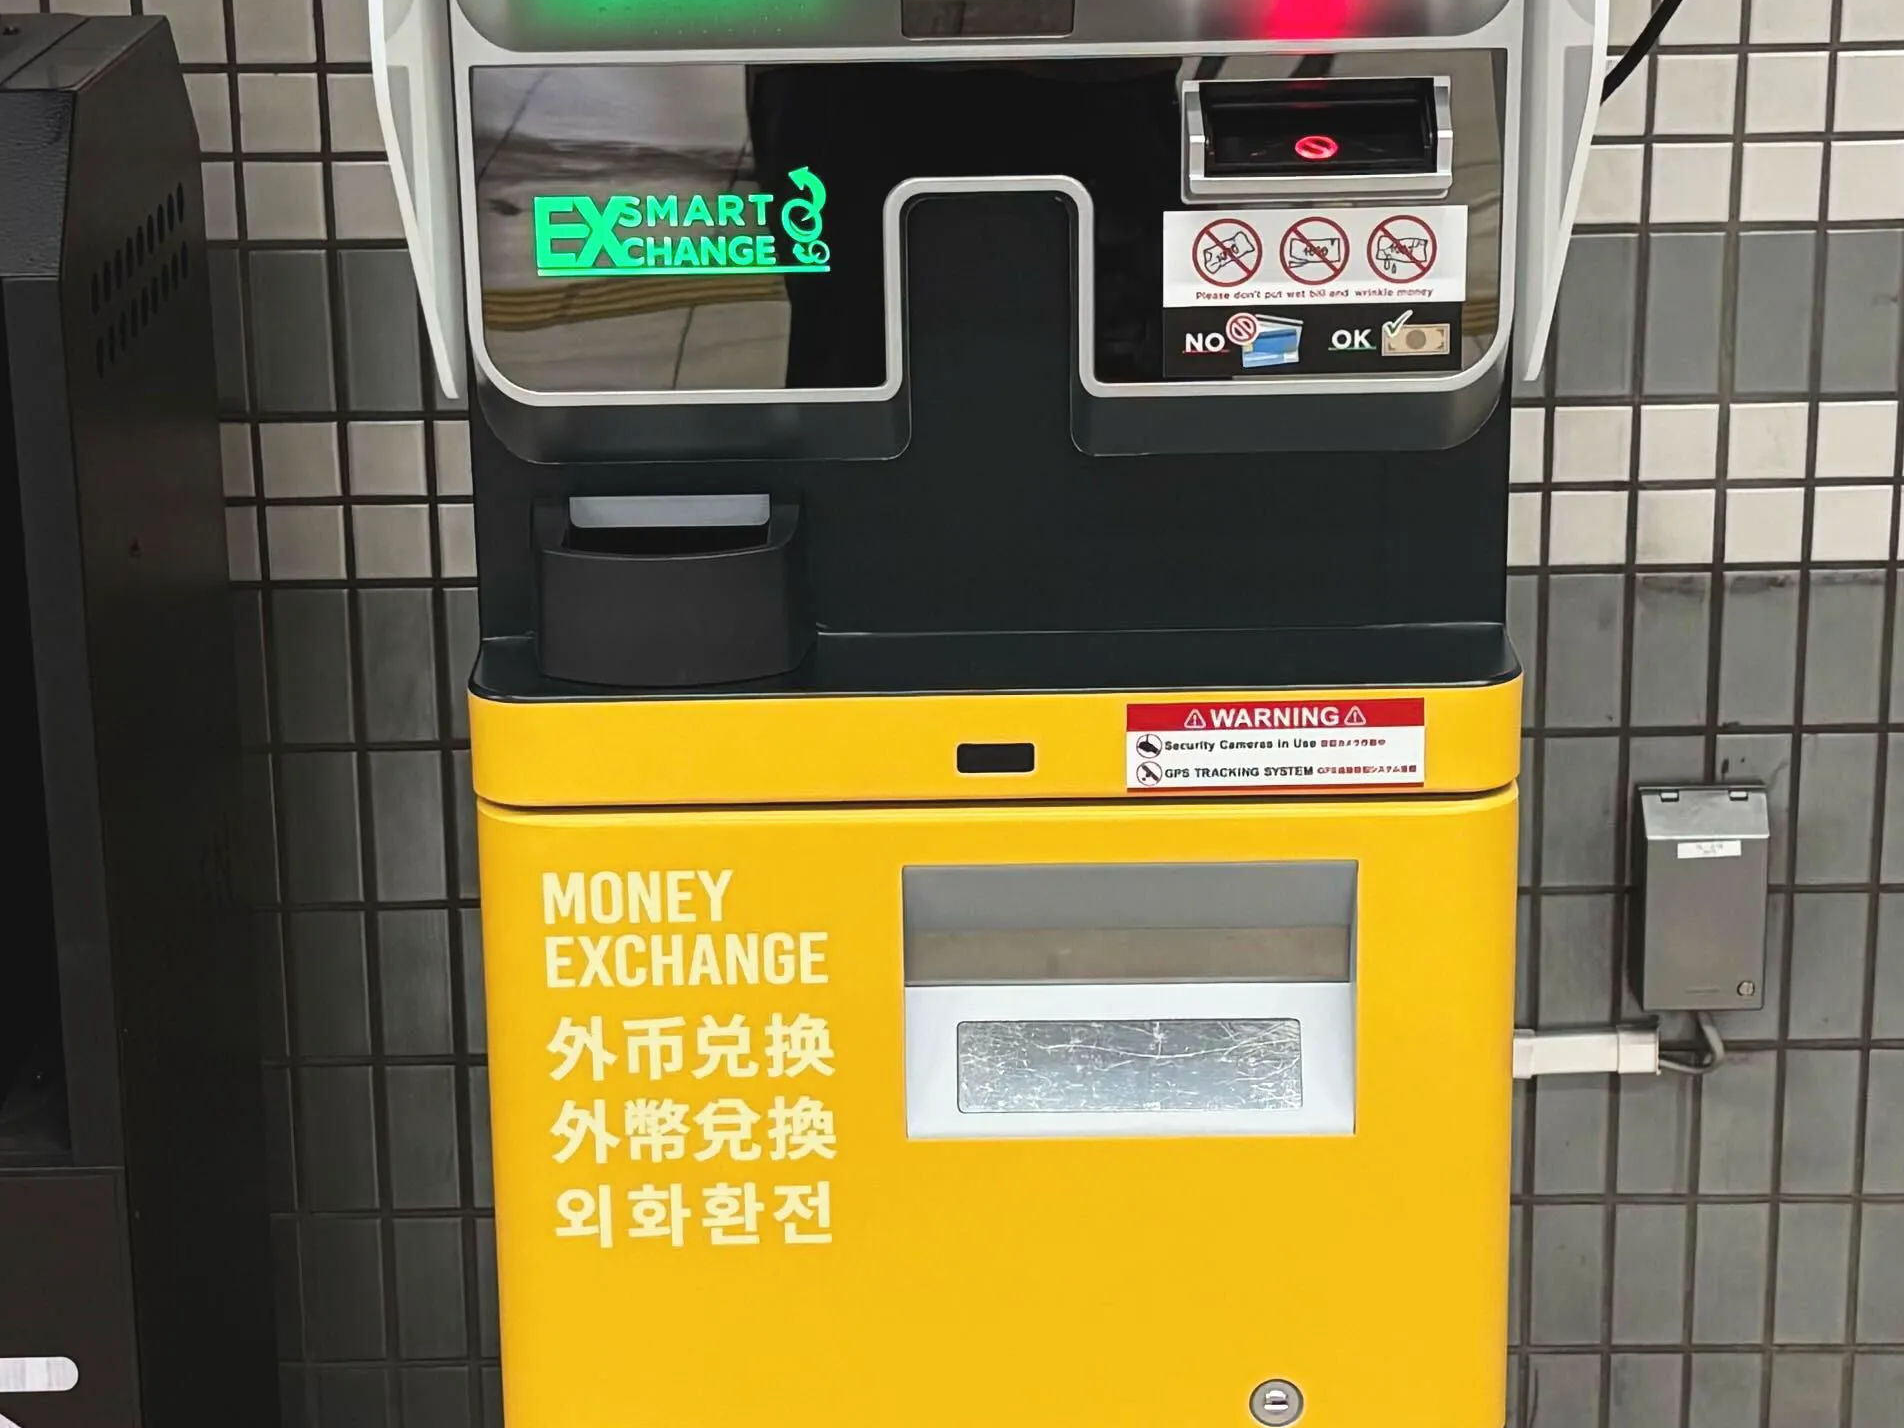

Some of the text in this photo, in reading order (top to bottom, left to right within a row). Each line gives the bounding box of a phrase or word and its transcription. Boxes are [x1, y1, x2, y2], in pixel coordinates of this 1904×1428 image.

[618, 194, 774, 228] SMART
[1196, 290, 1230, 300] Please
[1287, 290, 1306, 298] wet
[1329, 290, 1349, 298] and
[1184, 332, 1225, 353] NO
[1331, 329, 1371, 349] OK
[1210, 706, 1339, 728] WARNING
[1165, 740, 1215, 752] Security
[1220, 739, 1273, 750] Cameras
[1294, 738, 1316, 749] Use
[1165, 768, 1190, 779] GPS
[1196, 767, 1260, 778] TRACKING
[1264, 766, 1313, 777] SYSTEM
[542, 869, 734, 925] MONEY
[545, 932, 829, 989] EXCHANGE
[555, 1181, 833, 1249] 외화환전
